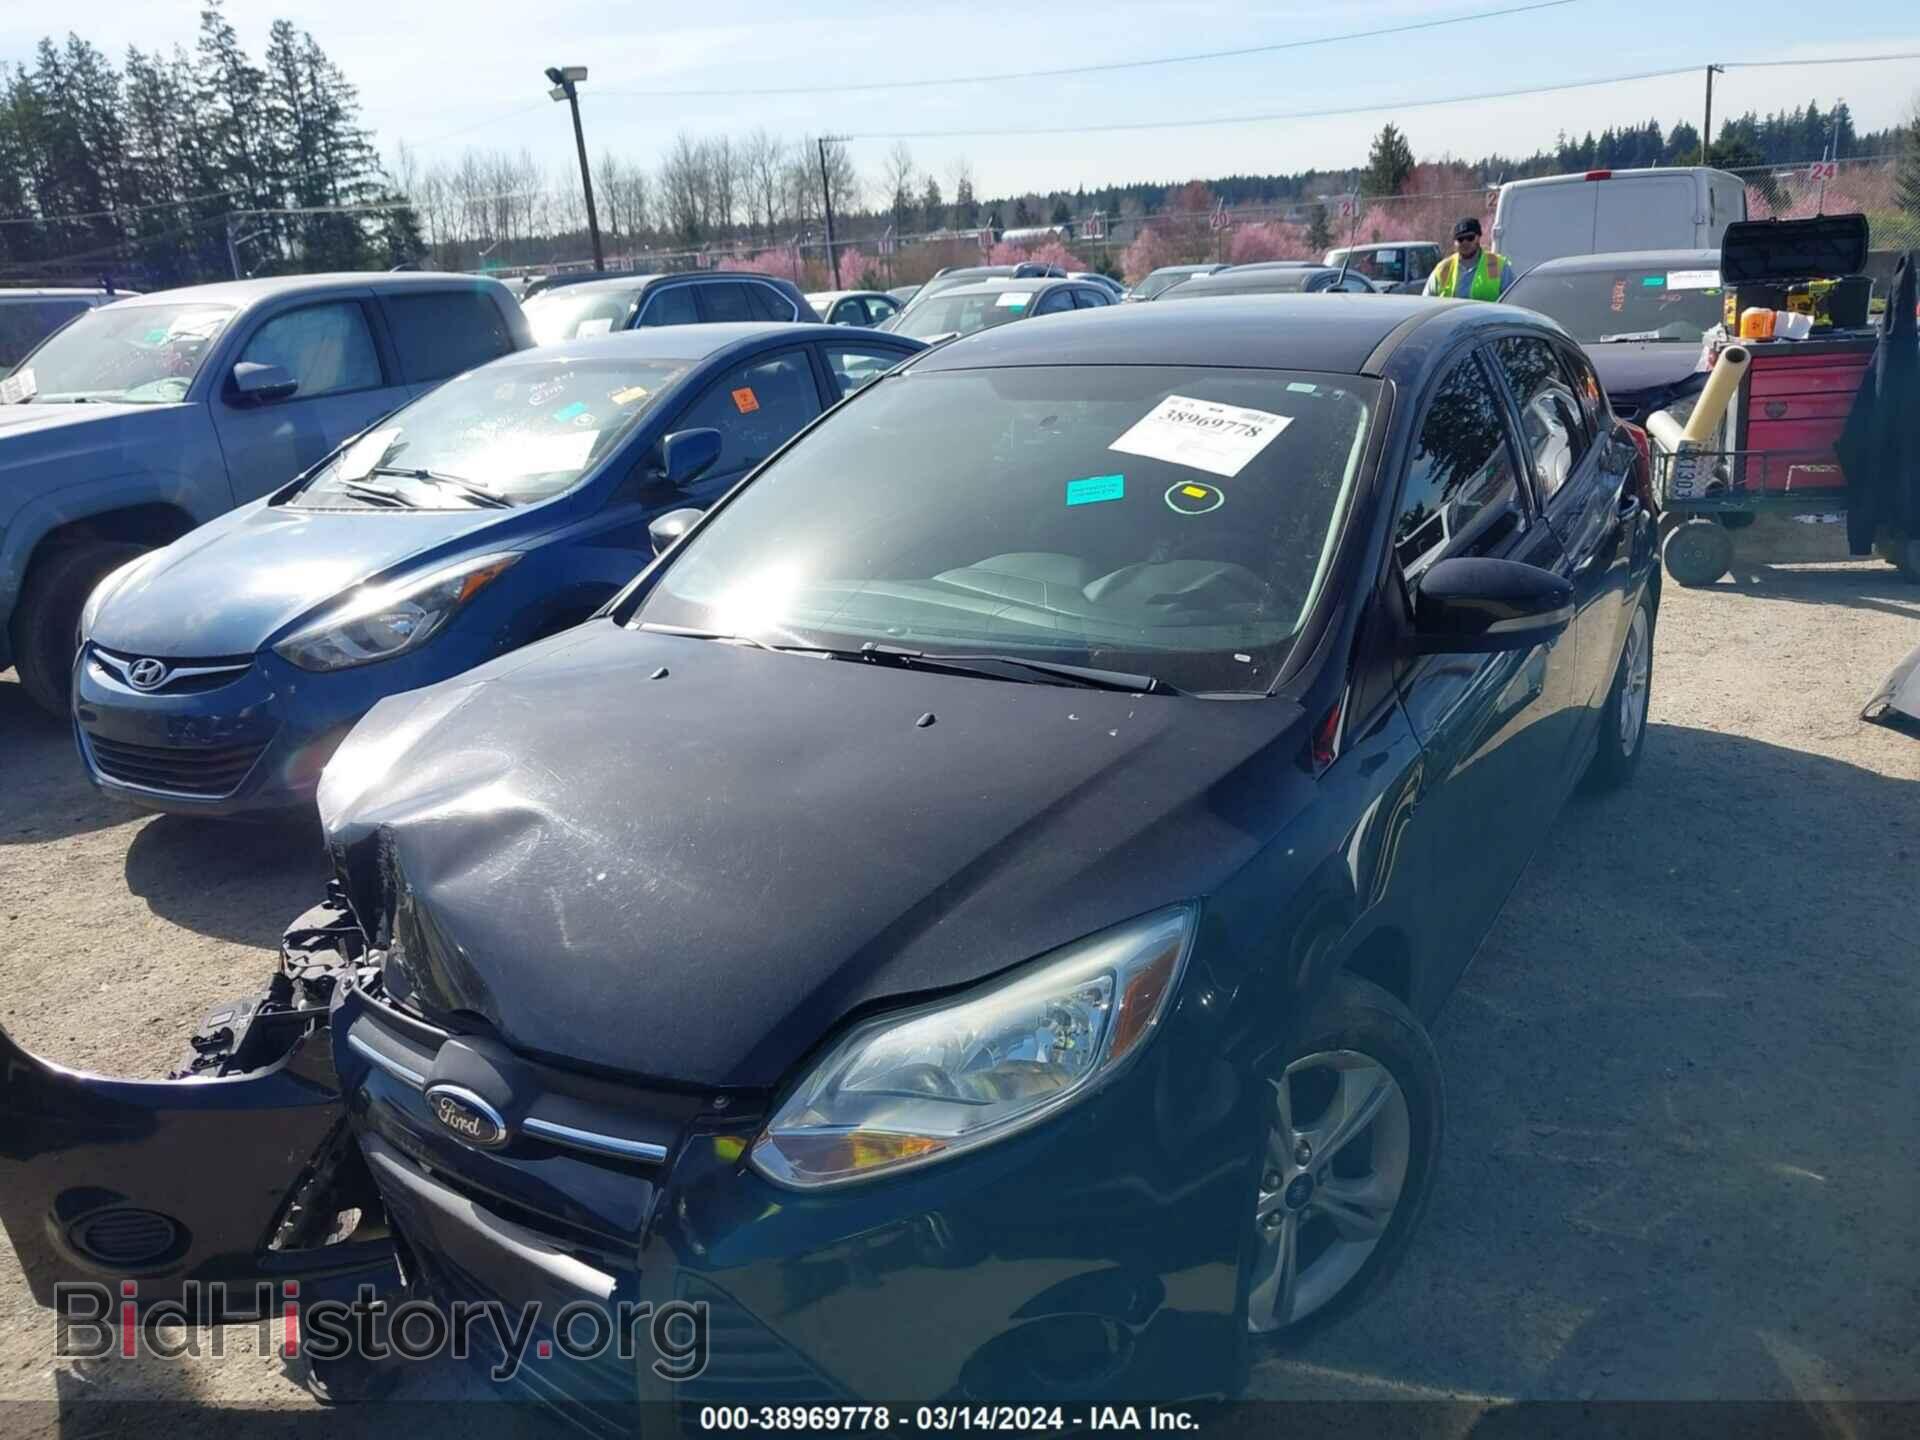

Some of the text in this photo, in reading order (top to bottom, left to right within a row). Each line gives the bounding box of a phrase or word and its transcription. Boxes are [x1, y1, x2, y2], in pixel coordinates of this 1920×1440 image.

[1811, 163, 1835, 180] 24
[1159, 409, 1263, 437] 38969778
[438, 1097, 481, 1136] Ford
